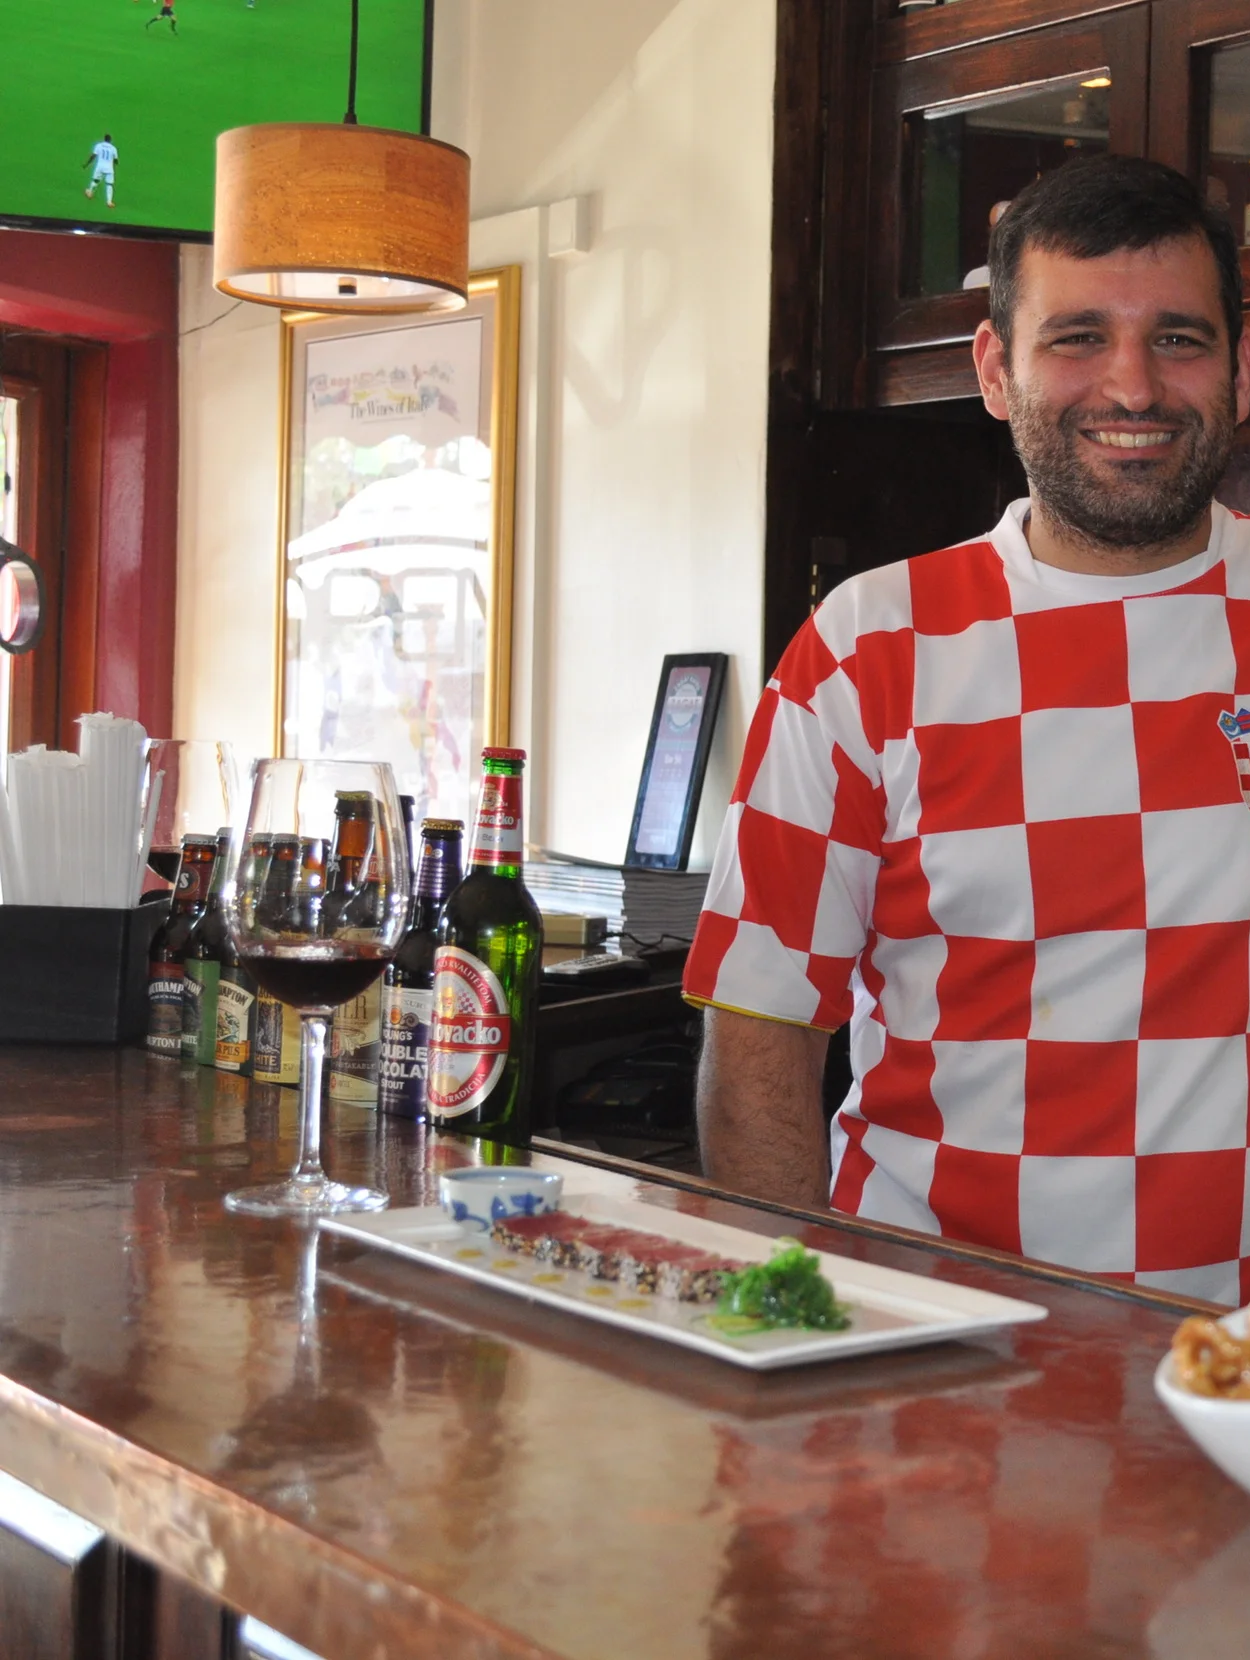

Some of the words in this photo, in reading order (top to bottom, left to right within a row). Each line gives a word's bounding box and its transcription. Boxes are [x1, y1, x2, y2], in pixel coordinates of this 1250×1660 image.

[350, 402, 364, 420] The
[365, 398, 394, 417] Wines
[381, 1078, 405, 1090] STOUT
